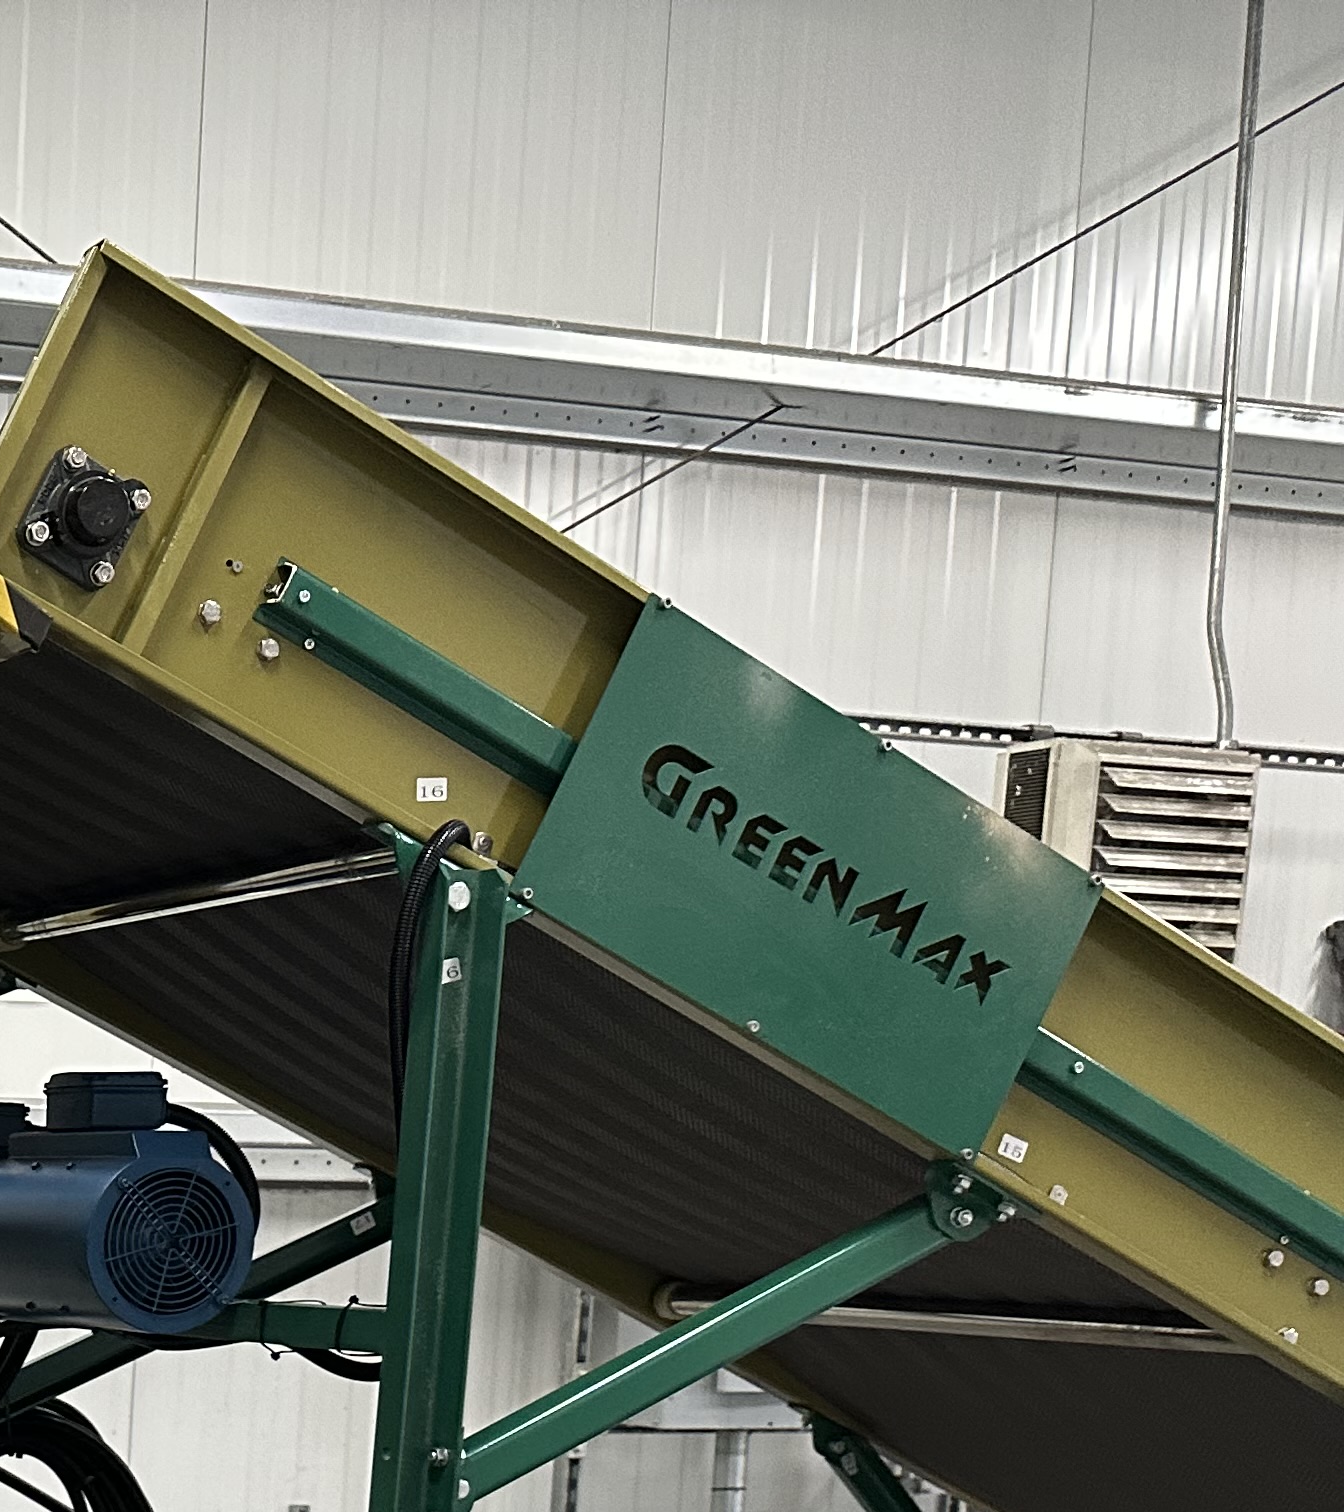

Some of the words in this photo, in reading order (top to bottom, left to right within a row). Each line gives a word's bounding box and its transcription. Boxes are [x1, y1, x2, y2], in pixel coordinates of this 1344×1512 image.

[421, 785, 444, 799] 16
[446, 965, 459, 979] 6
[1002, 1142, 1024, 1159] 15
